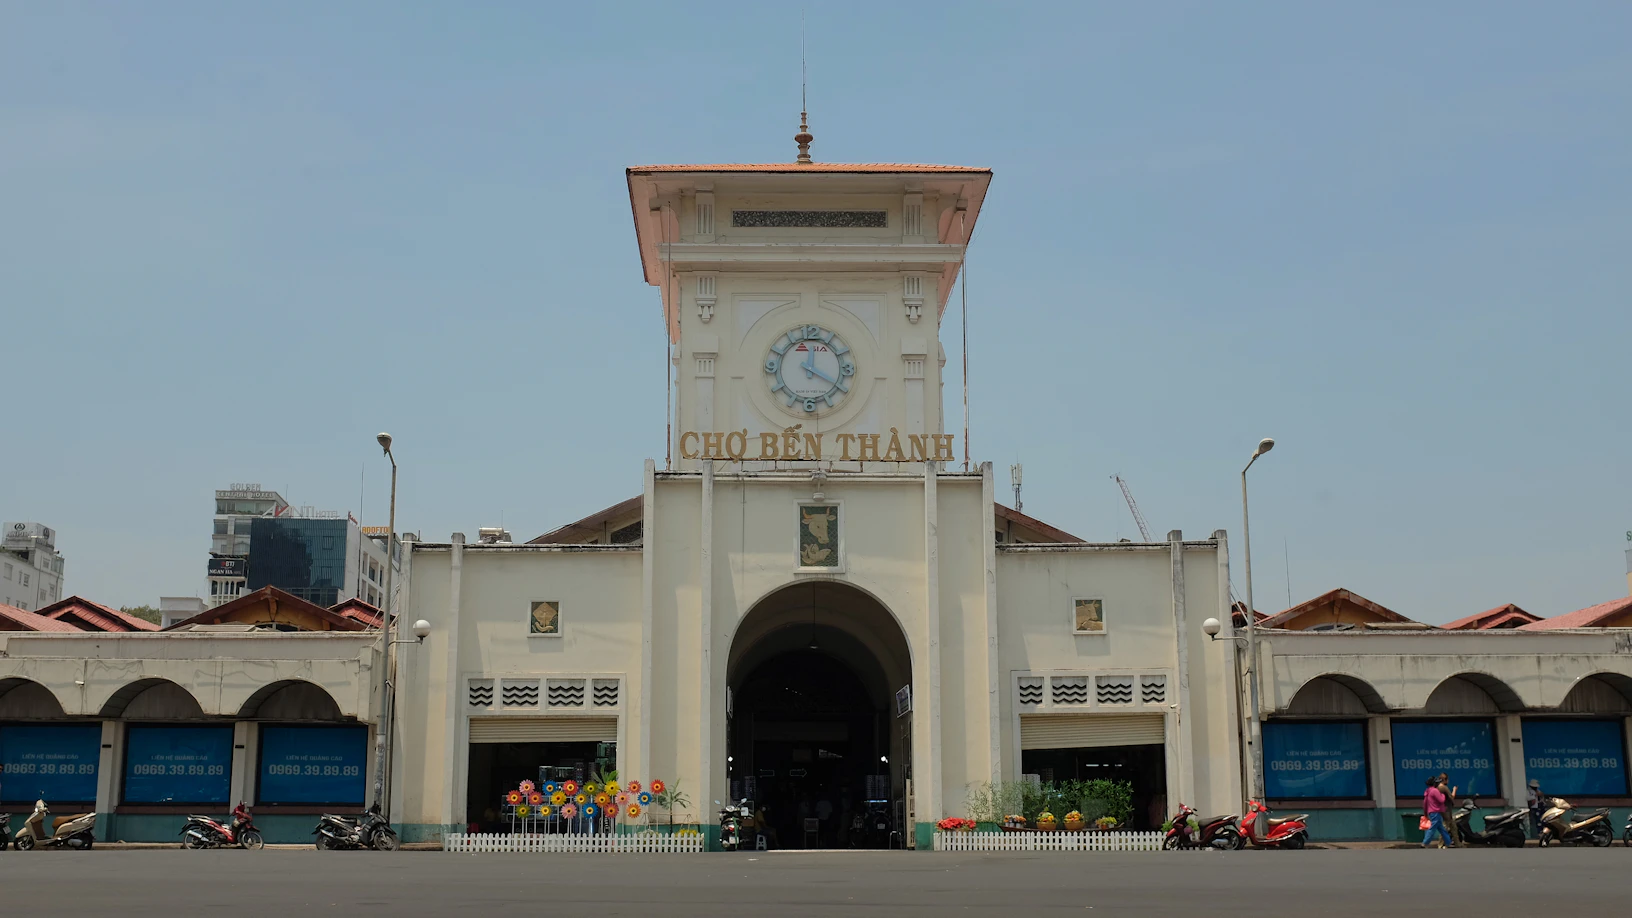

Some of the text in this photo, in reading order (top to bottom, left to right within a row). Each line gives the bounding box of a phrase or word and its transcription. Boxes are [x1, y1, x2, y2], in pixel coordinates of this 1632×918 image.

[801, 325, 820, 340] 12
[764, 359, 778, 373] 9
[841, 361, 855, 377] 3
[803, 398, 817, 412] 6
[679, 424, 955, 464] CHỢ BẾN THÀNH
[362, 526, 391, 534] ROOFTO
[4, 763, 95, 775] 0969.39.89.89
[1270, 760, 1359, 771] 0969.39.89.89
[1401, 759, 1489, 769] 0969.39.89.89
[1529, 757, 1618, 769] 0969.39.89.89
[133, 764, 224, 776] 0969.39.89.89
[268, 764, 359, 776] 0969.39.89.89
